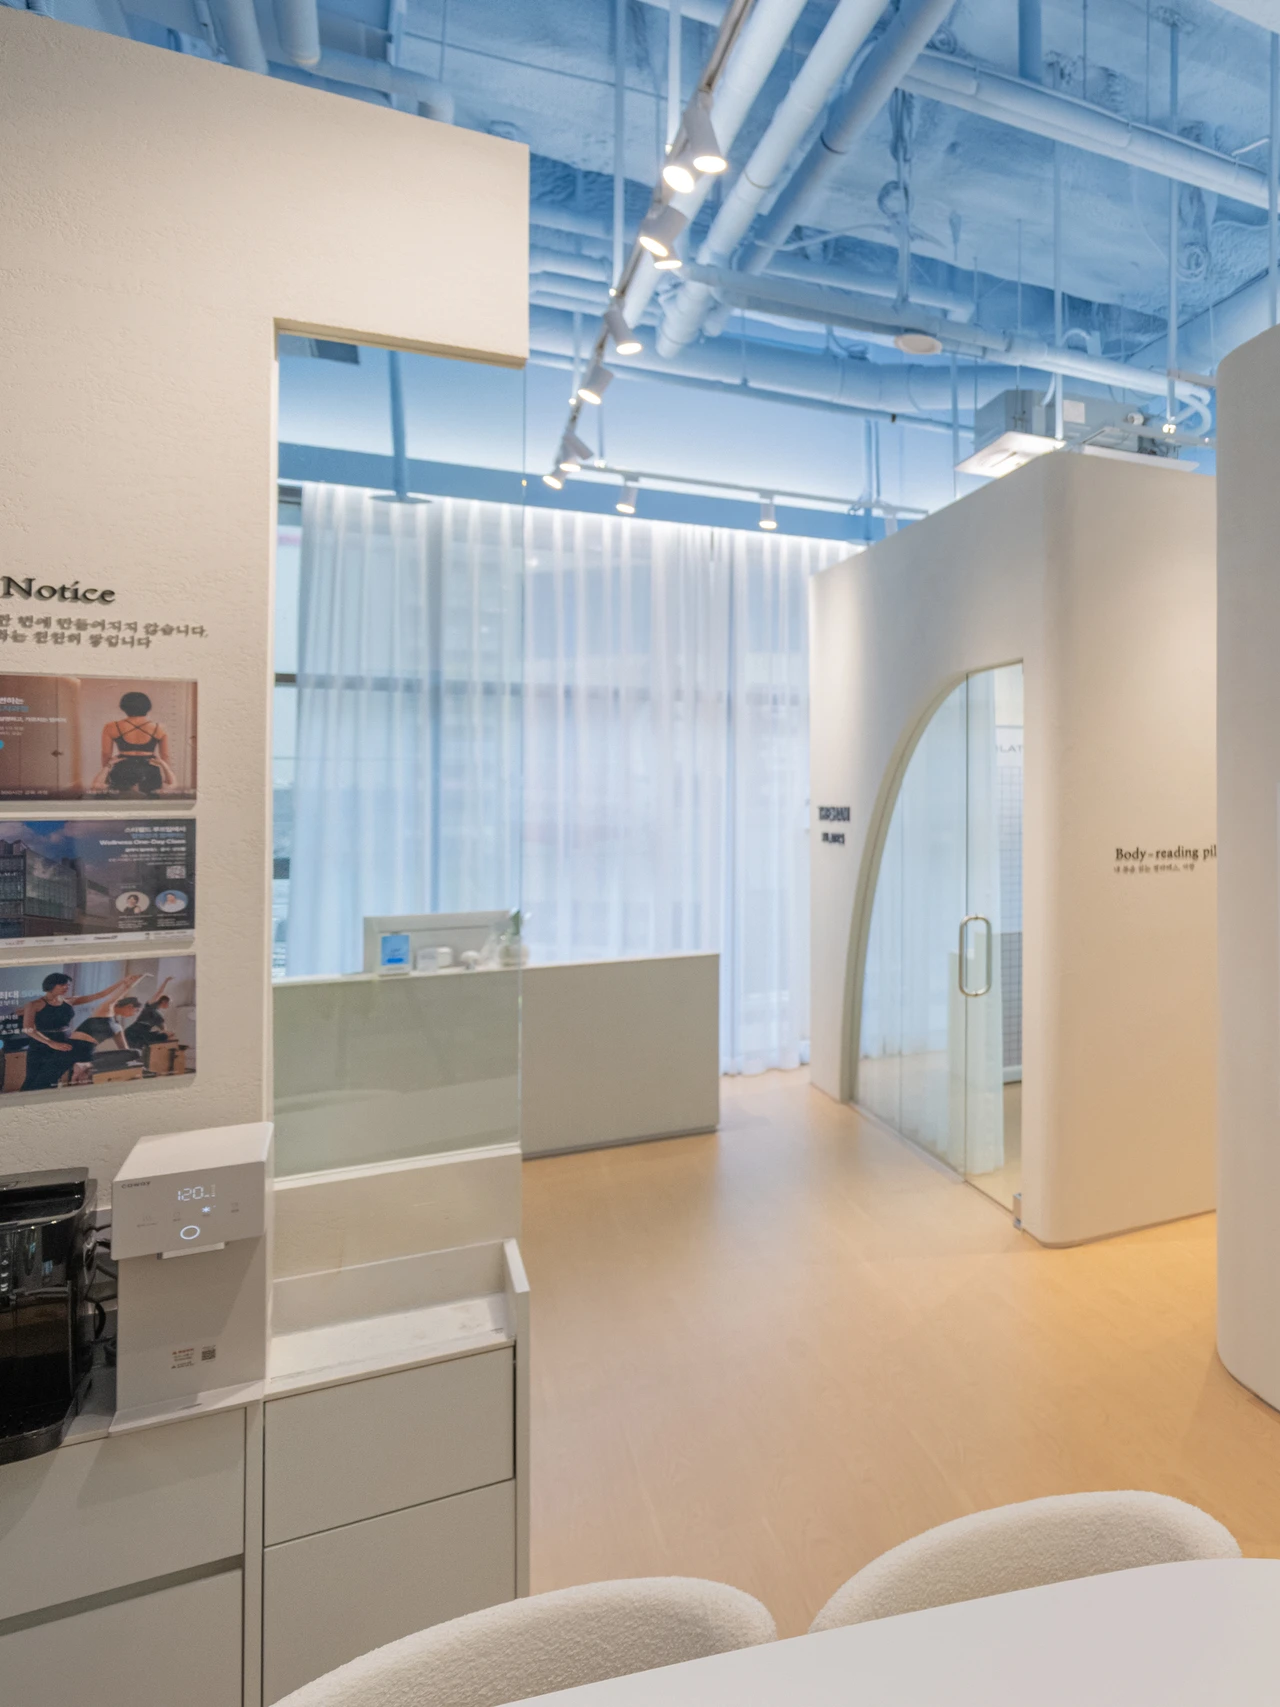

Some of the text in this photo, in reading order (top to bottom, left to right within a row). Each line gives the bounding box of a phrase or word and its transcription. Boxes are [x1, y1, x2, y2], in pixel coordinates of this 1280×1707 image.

[2, 576, 116, 603] Notice
[1203, 844, 1217, 861] pil
[178, 1186, 204, 1201] 120
